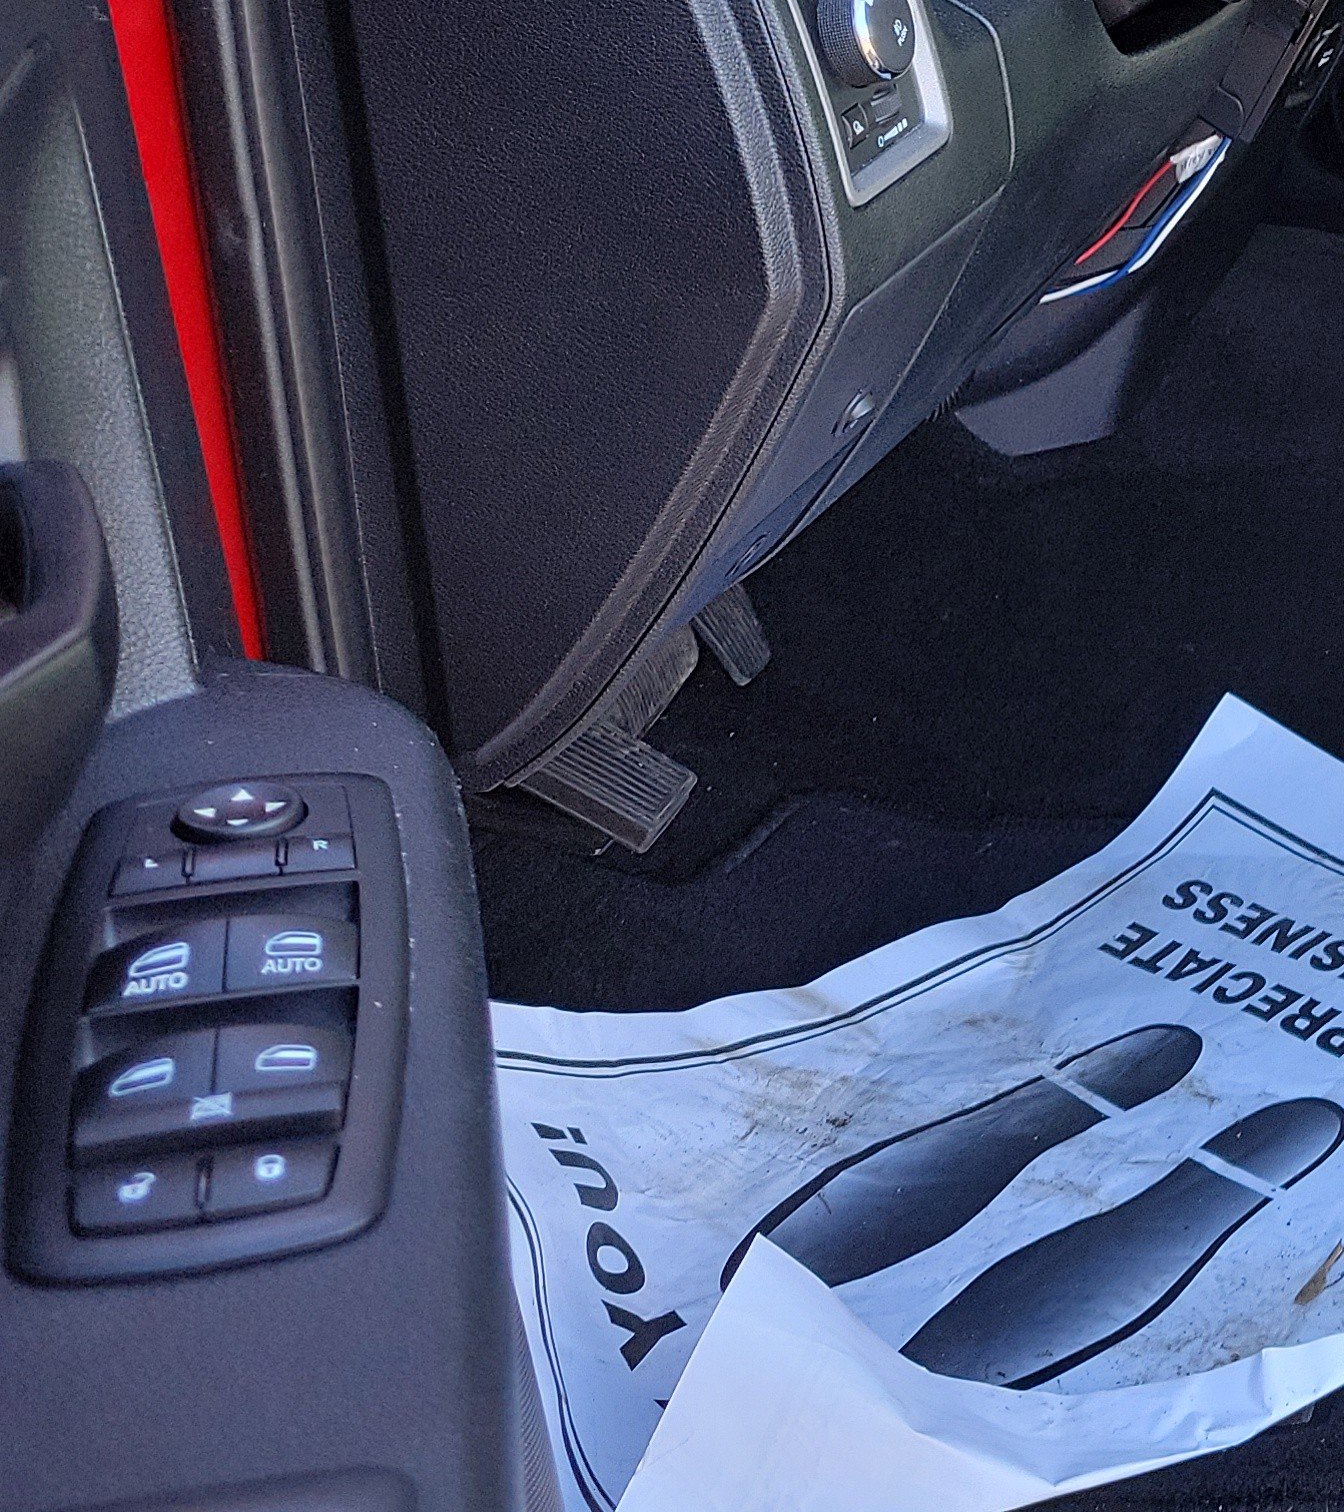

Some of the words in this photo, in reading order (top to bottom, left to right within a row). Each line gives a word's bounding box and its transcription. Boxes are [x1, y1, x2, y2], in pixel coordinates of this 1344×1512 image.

[261, 956, 323, 975] AUTO
[123, 971, 188, 997] AUTO
[531, 1122, 687, 1371] YOU!
